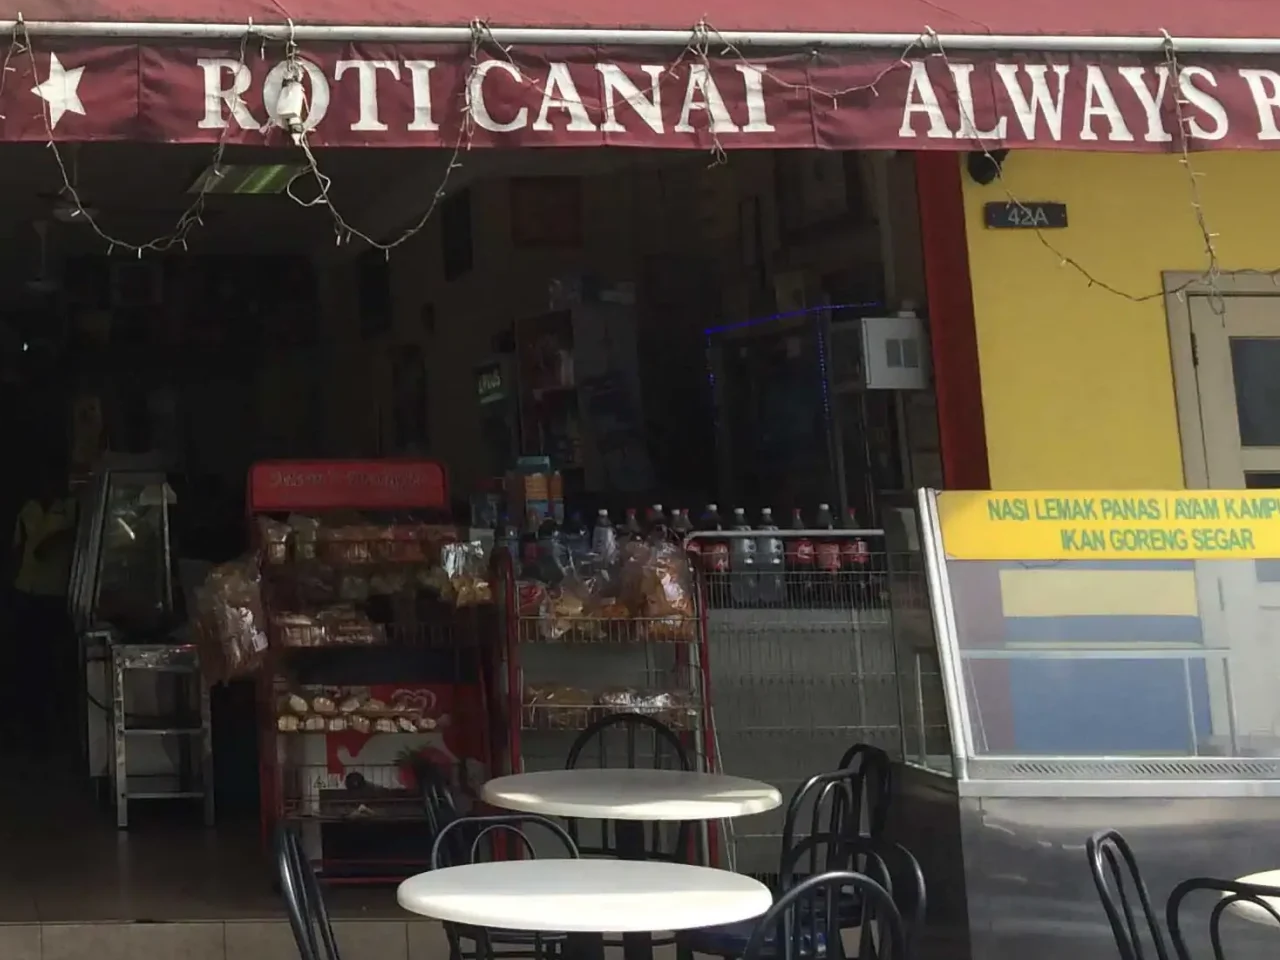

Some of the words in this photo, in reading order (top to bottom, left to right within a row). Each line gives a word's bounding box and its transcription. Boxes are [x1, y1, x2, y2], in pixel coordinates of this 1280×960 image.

[197, 54, 439, 132] ROTI
[468, 59, 776, 134] CANAI
[898, 60, 1229, 141] ALWAYS
[1007, 207, 1049, 226] 42A
[987, 499, 1030, 520] NASI
[1035, 499, 1098, 520] LEMAK
[1101, 499, 1161, 520] PANAS
[1175, 498, 1220, 519] AYAM
[1224, 498, 1280, 519] KAMP
[1060, 529, 1106, 551] IKAN
[1109, 529, 1189, 551] GORENG
[1191, 528, 1256, 551] SEGAR
